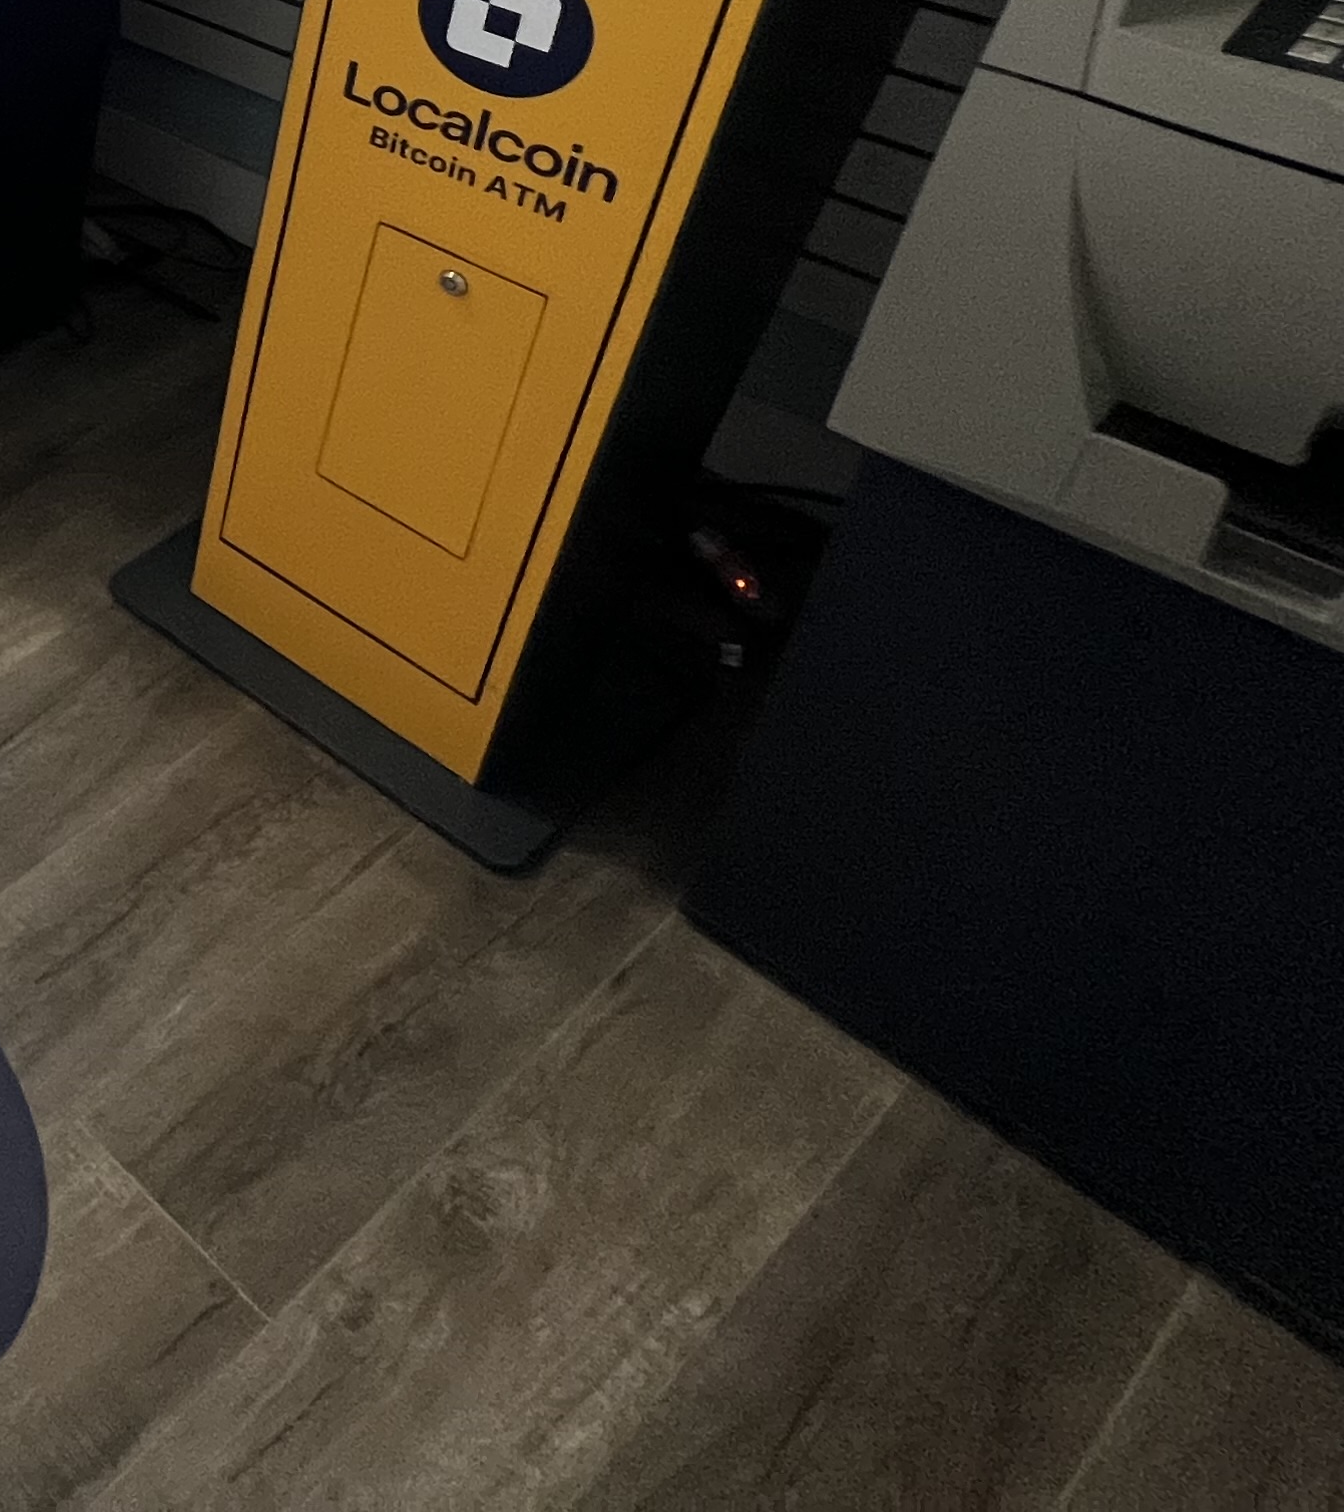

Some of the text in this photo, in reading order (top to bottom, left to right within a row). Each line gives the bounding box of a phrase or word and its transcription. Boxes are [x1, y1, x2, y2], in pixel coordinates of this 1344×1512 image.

[342, 60, 620, 204] Localcoin
[368, 125, 568, 224] Bitcoin ATM
